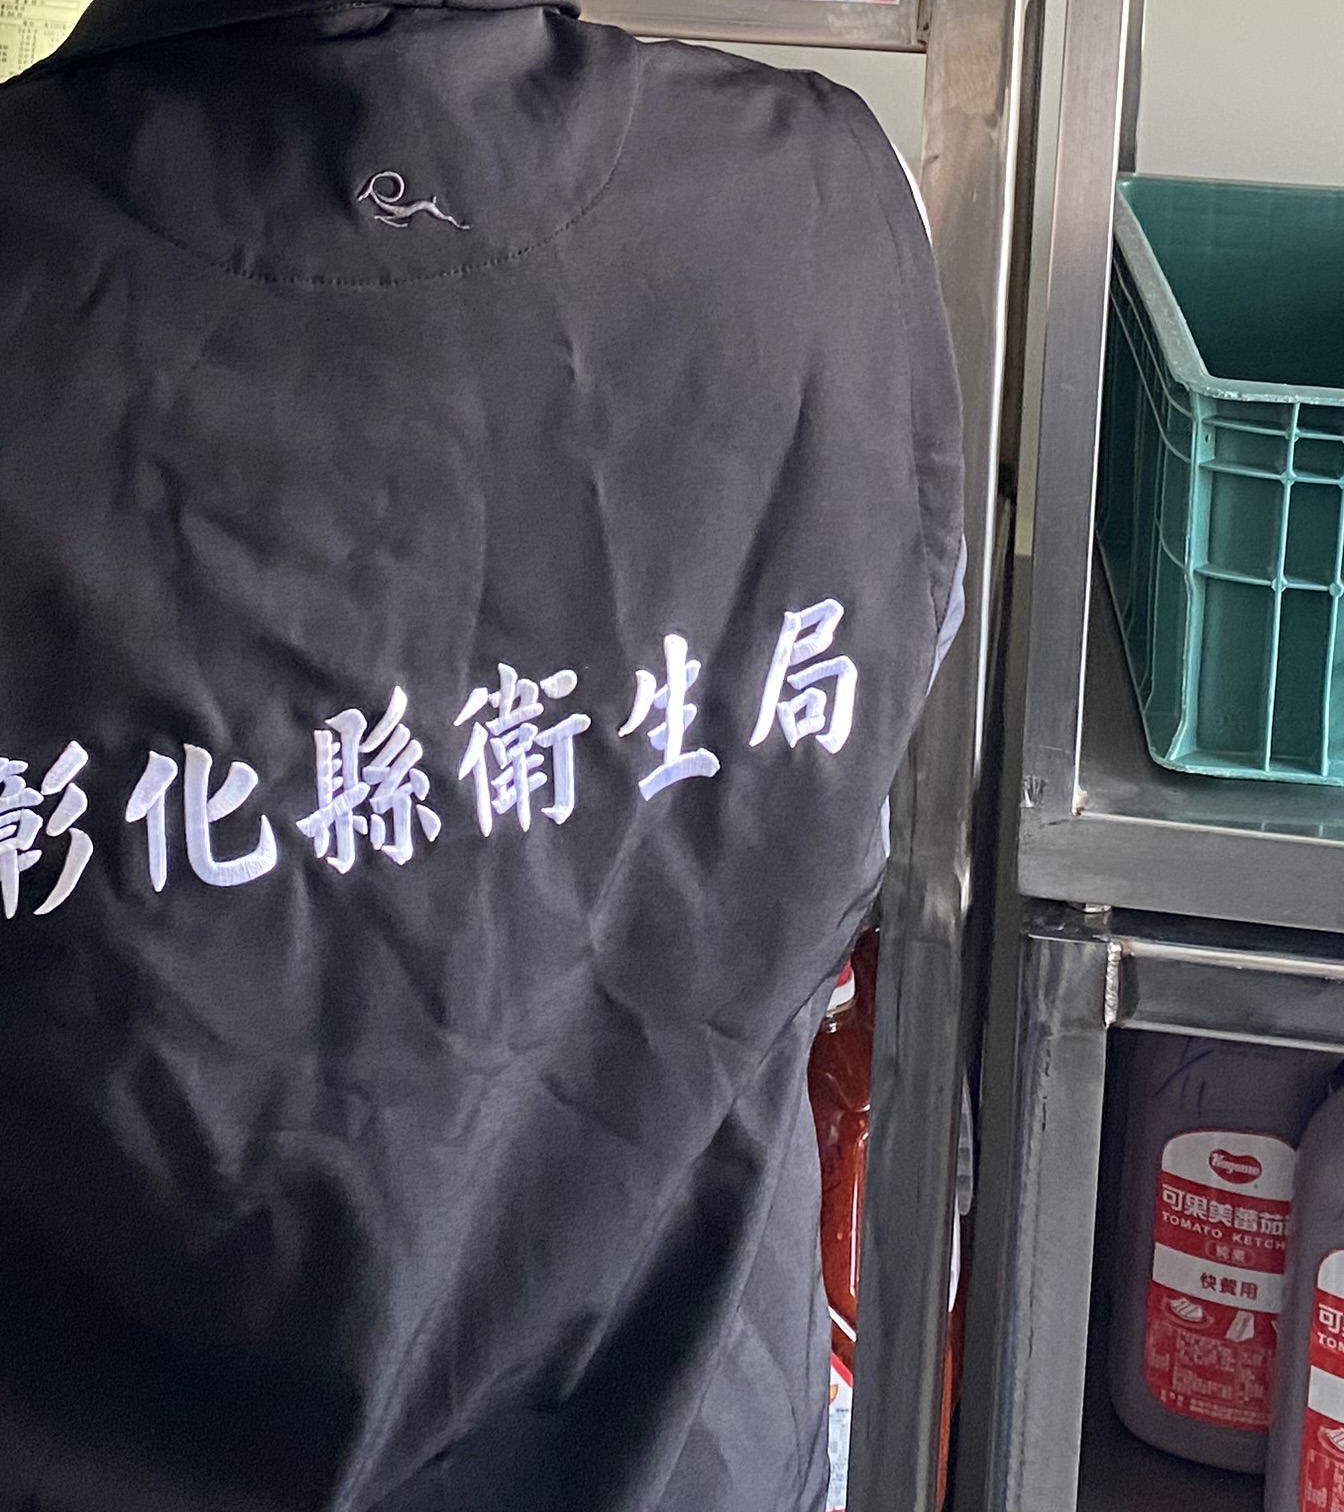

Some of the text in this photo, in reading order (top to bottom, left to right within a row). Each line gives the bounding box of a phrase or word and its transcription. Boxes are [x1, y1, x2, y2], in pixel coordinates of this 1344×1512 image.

[1161, 1183, 1290, 1237] 可果美蕃茄
[1161, 1210, 1223, 1240] TOMATO
[1199, 1272, 1259, 1301] 快餐用
